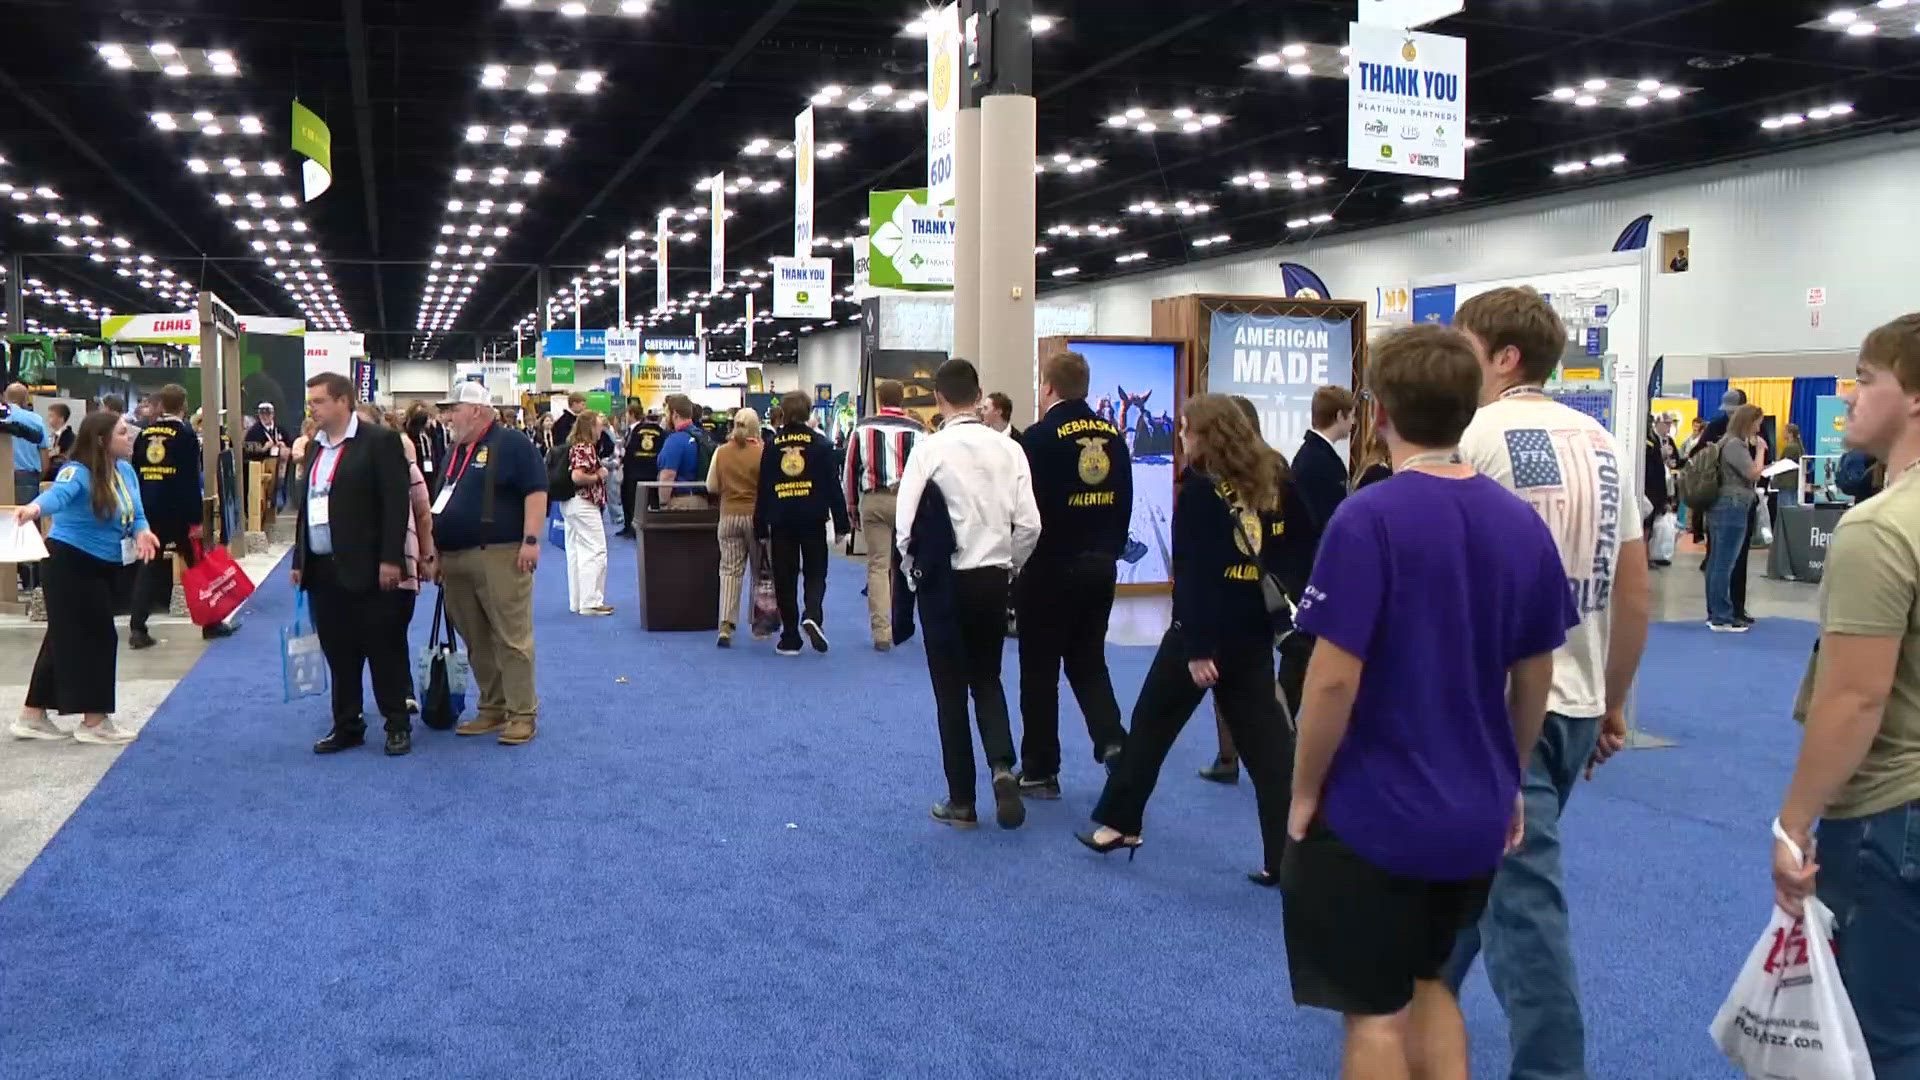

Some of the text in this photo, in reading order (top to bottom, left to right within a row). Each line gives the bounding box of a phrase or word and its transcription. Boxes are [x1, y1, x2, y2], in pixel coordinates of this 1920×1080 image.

[1359, 61, 1457, 102] THANK YOU
[1358, 103, 1458, 121] PLATINUM PARTNERS
[930, 154, 951, 187] 600
[912, 219, 947, 234] THANK
[781, 268, 825, 281] THANK YOU
[153, 319, 192, 332] CLAAS
[644, 339, 695, 350] CATERPILLAR
[1234, 326, 1329, 349] AMERICAN
[717, 362, 743, 375] CHS
[1232, 349, 1329, 385] MADE
[1057, 419, 1119, 438] NEBRASKA
[774, 433, 812, 445] ILLINOIS
[1519, 450, 1551, 463] FFA
[1068, 491, 1115, 506] VALENTINE
[1592, 450, 1620, 575] FOREVER
